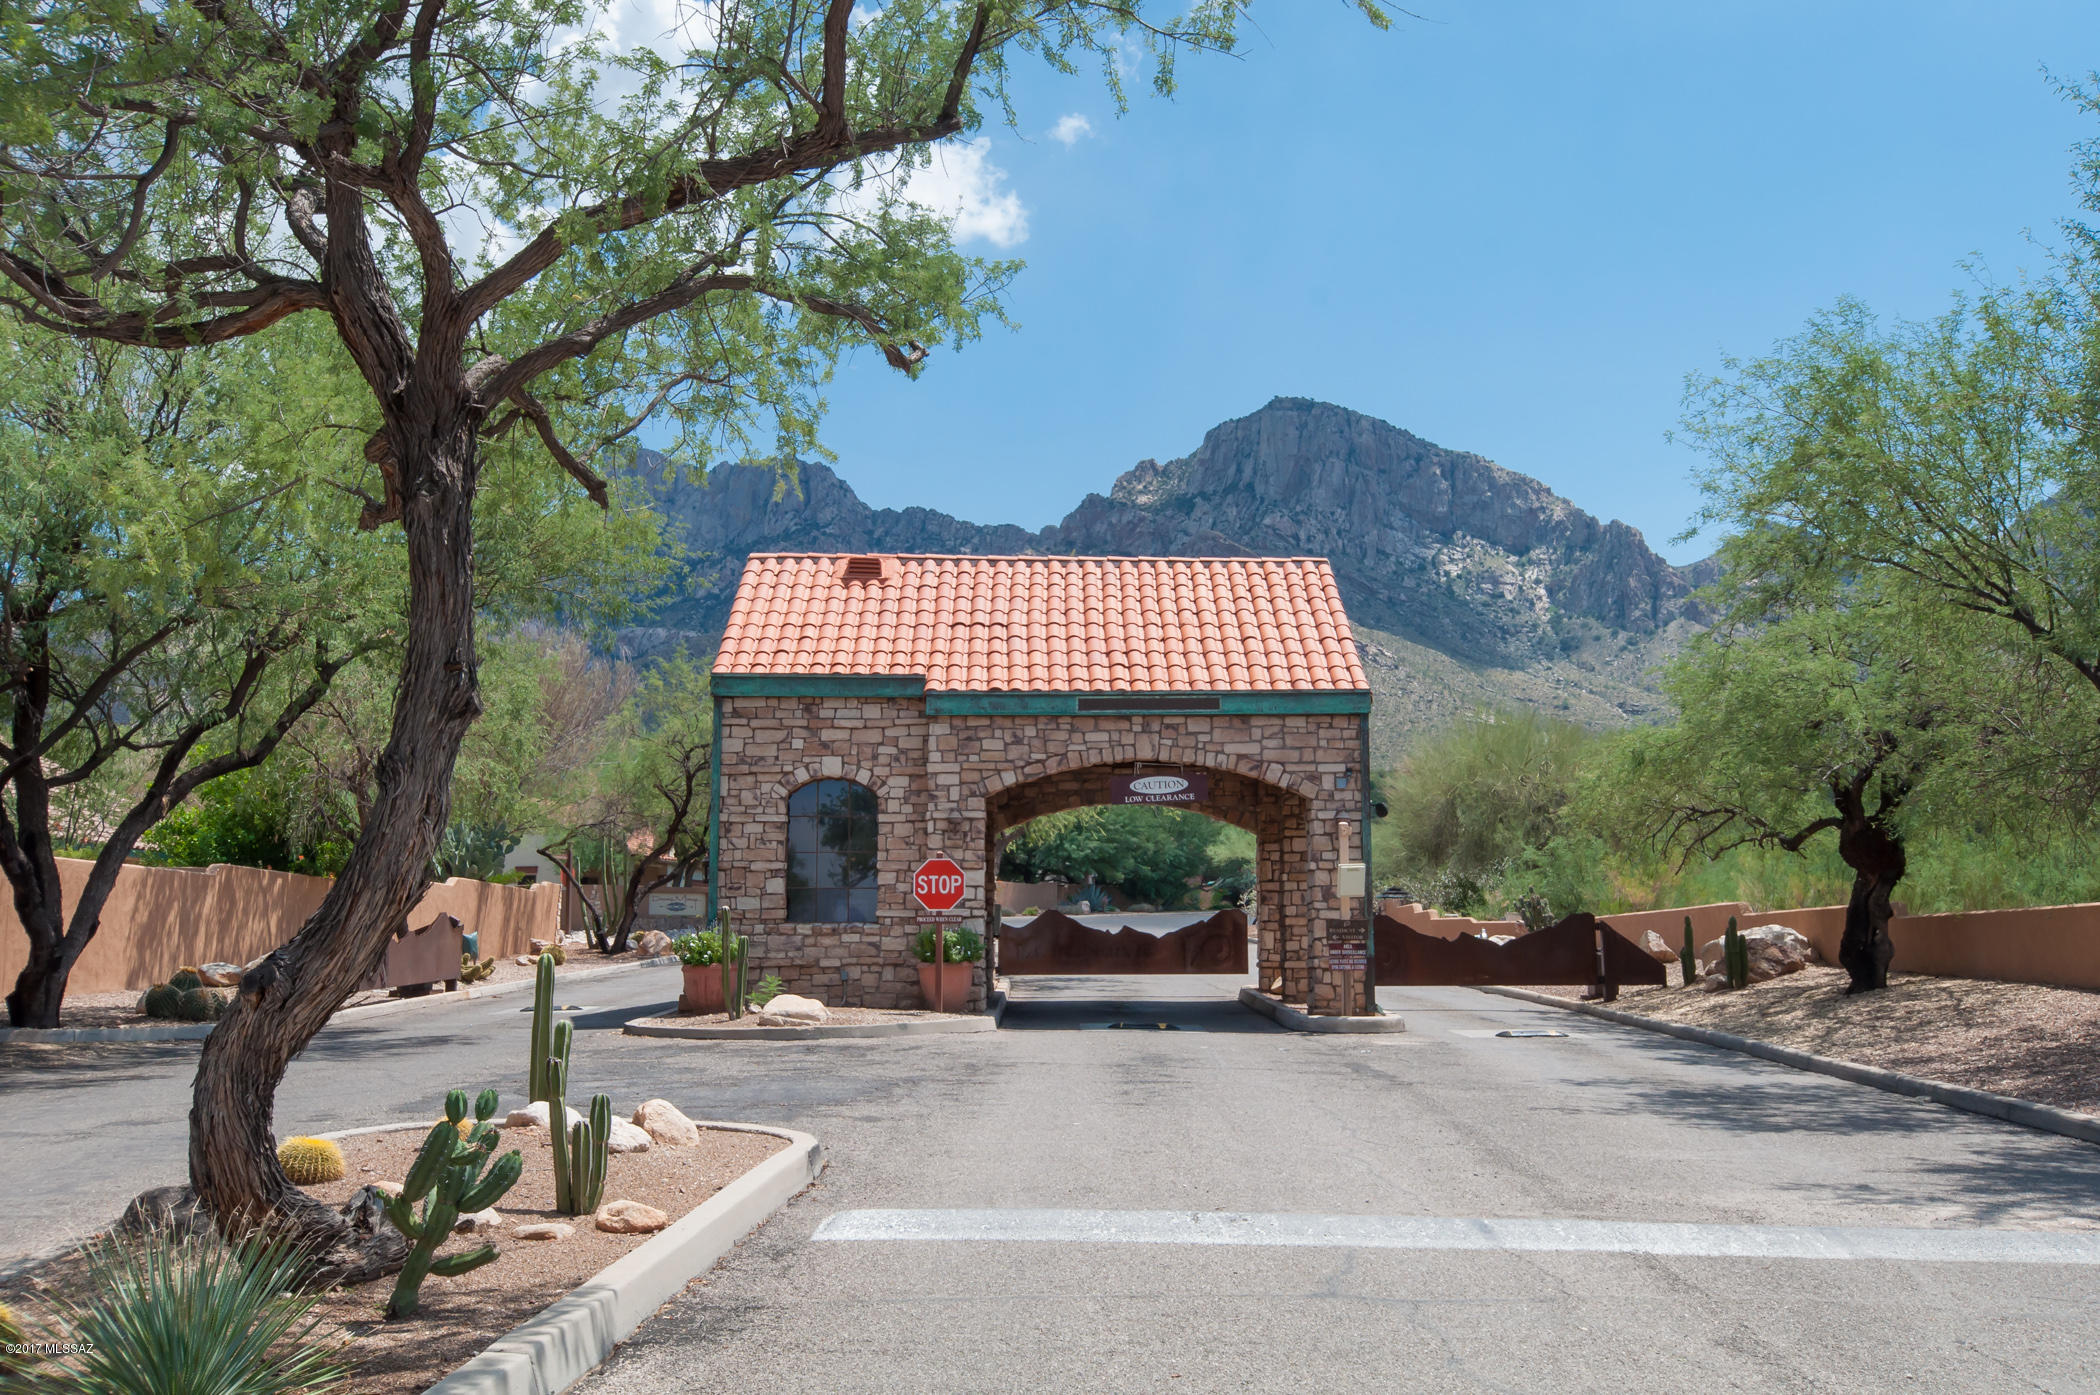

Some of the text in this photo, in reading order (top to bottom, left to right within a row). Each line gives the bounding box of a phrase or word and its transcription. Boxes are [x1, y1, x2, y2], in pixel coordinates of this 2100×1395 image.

[1133, 780, 1184, 790] CAUTION
[1125, 793, 1195, 803] LOW CLEARANCE
[917, 875, 962, 894] STOP
